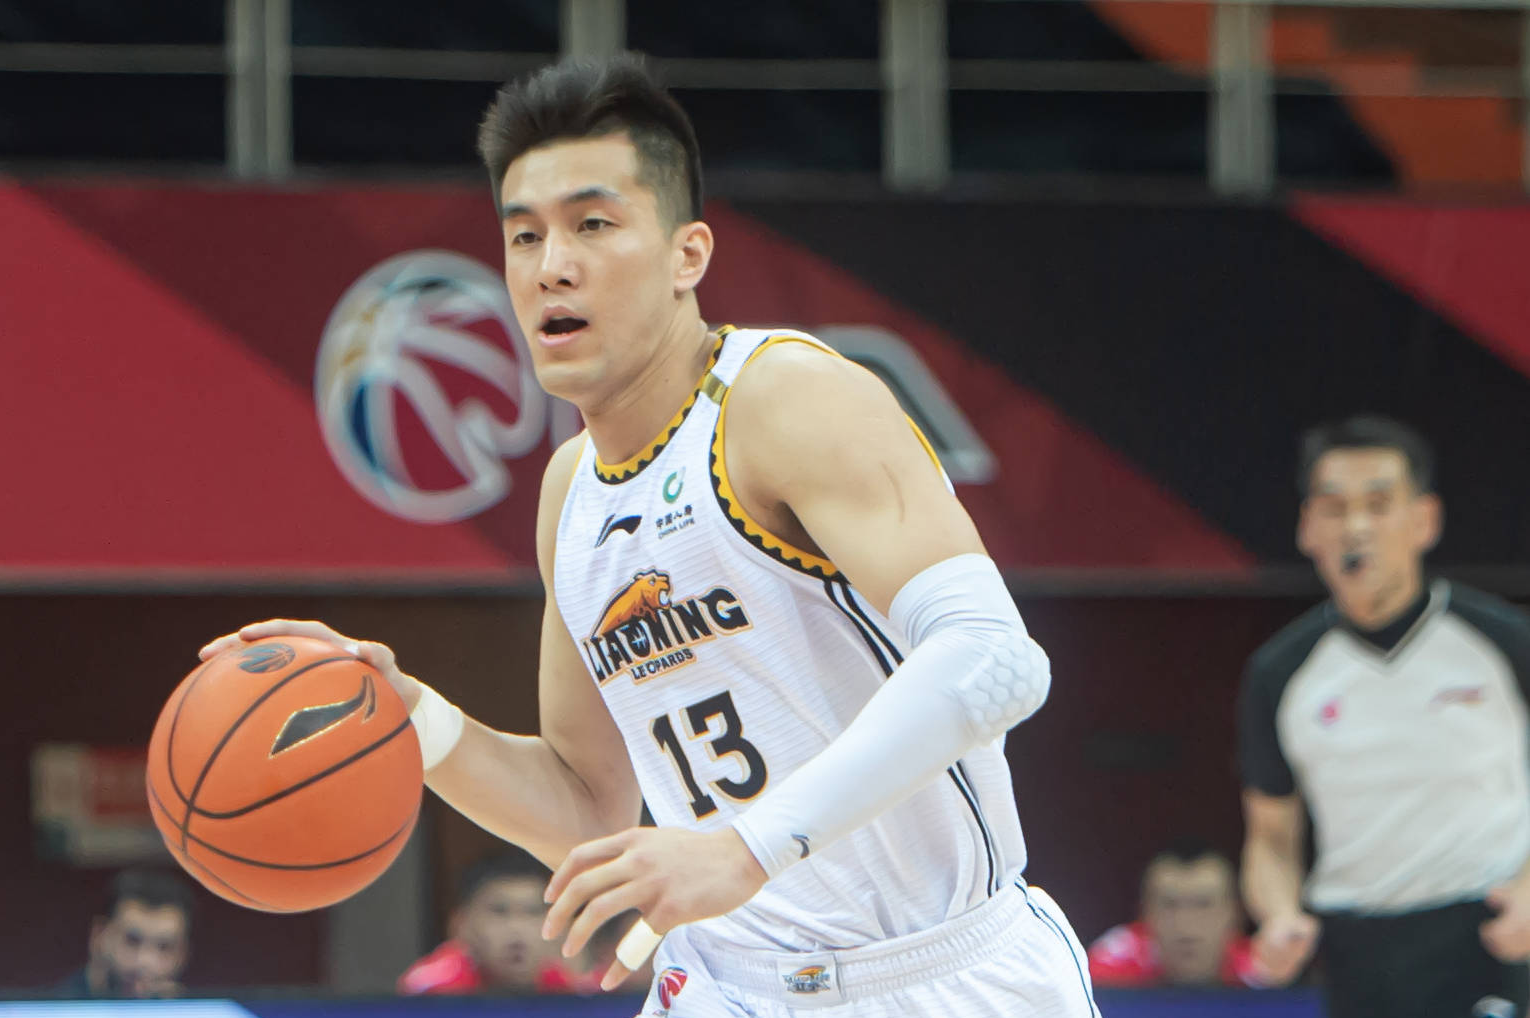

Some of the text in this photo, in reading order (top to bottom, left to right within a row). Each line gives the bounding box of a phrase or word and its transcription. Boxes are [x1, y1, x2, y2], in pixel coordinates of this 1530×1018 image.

[582, 586, 751, 683] LIAONING
[630, 647, 694, 680] LEOPARDS
[648, 690, 769, 821] 13
